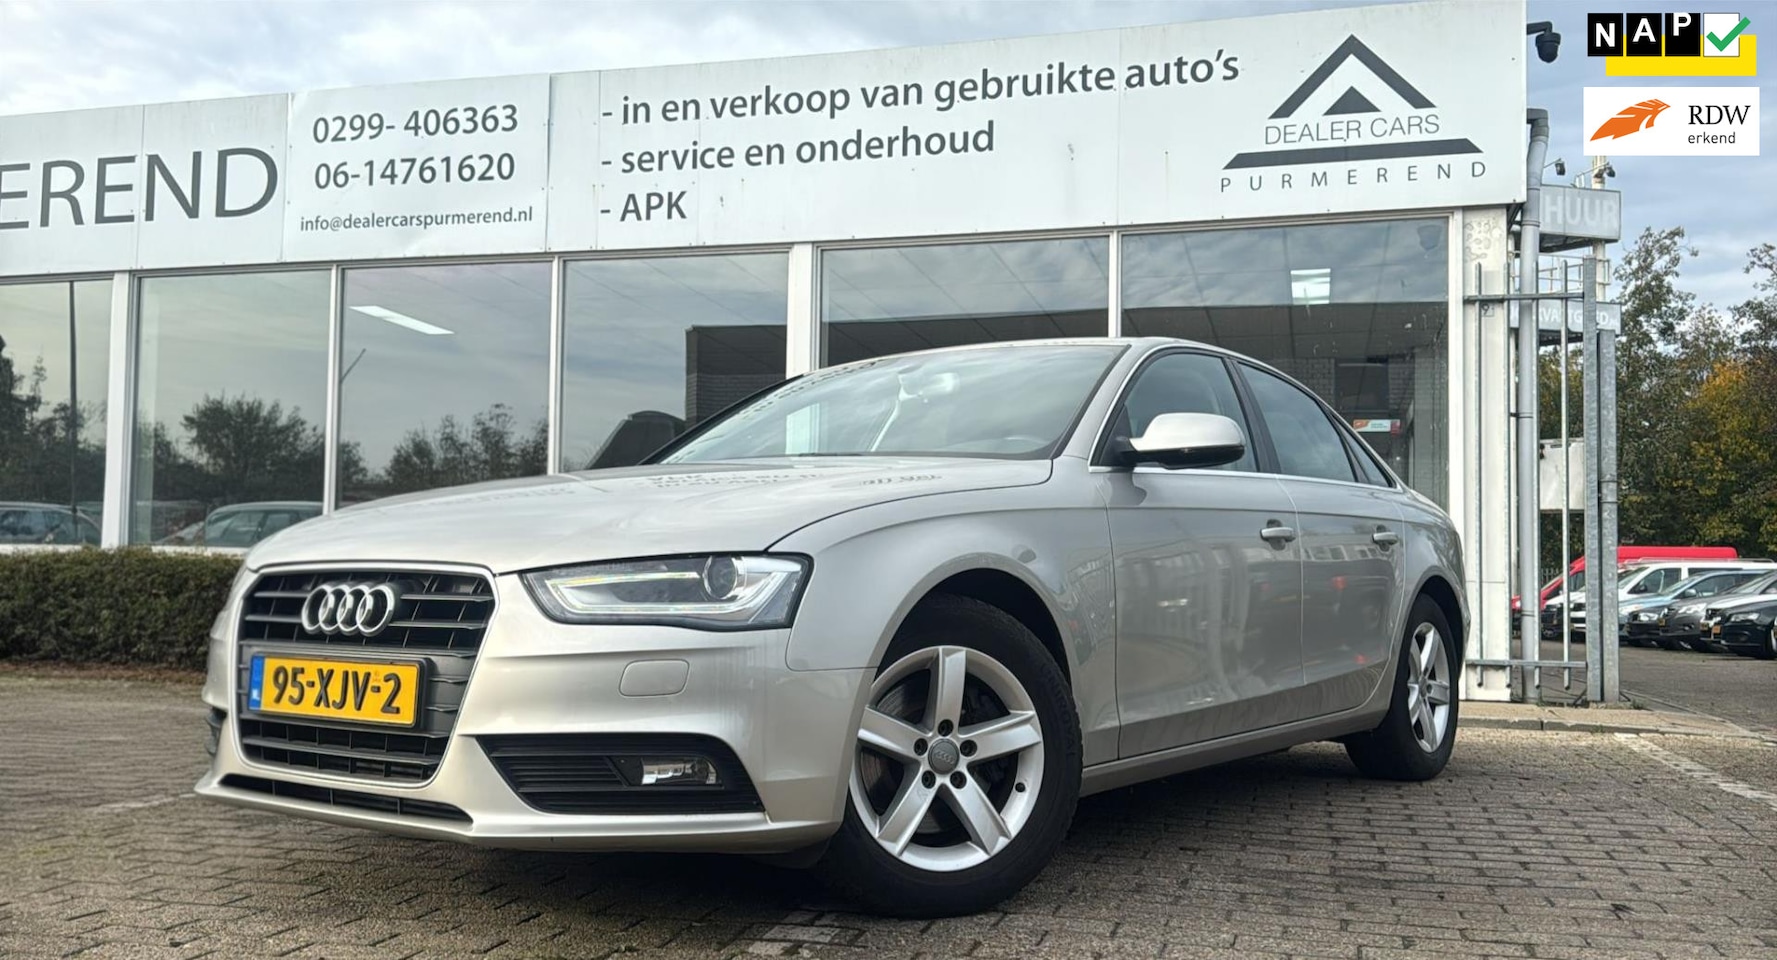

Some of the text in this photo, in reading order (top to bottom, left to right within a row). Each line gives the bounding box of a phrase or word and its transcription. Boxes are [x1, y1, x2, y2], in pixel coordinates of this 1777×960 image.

[622, 95, 651, 125] in
[661, 98, 701, 122] en
[710, 84, 851, 120] verkoop
[860, 82, 923, 109] van
[934, 61, 1116, 112] gebruikte
[313, 104, 518, 144] 0299- 406363
[1265, 113, 1440, 145] DEALER CARS
[621, 140, 735, 174] service
[744, 143, 785, 167] en
[795, 119, 994, 164] onderhoud
[314, 152, 515, 190] 06-14761620
[300, 205, 533, 232] info@dealercarspurmerend.nl
[619, 190, 688, 222] APK
[1544, 193, 1618, 230] HUUR
[272, 664, 402, 715] 95-XJV-2
